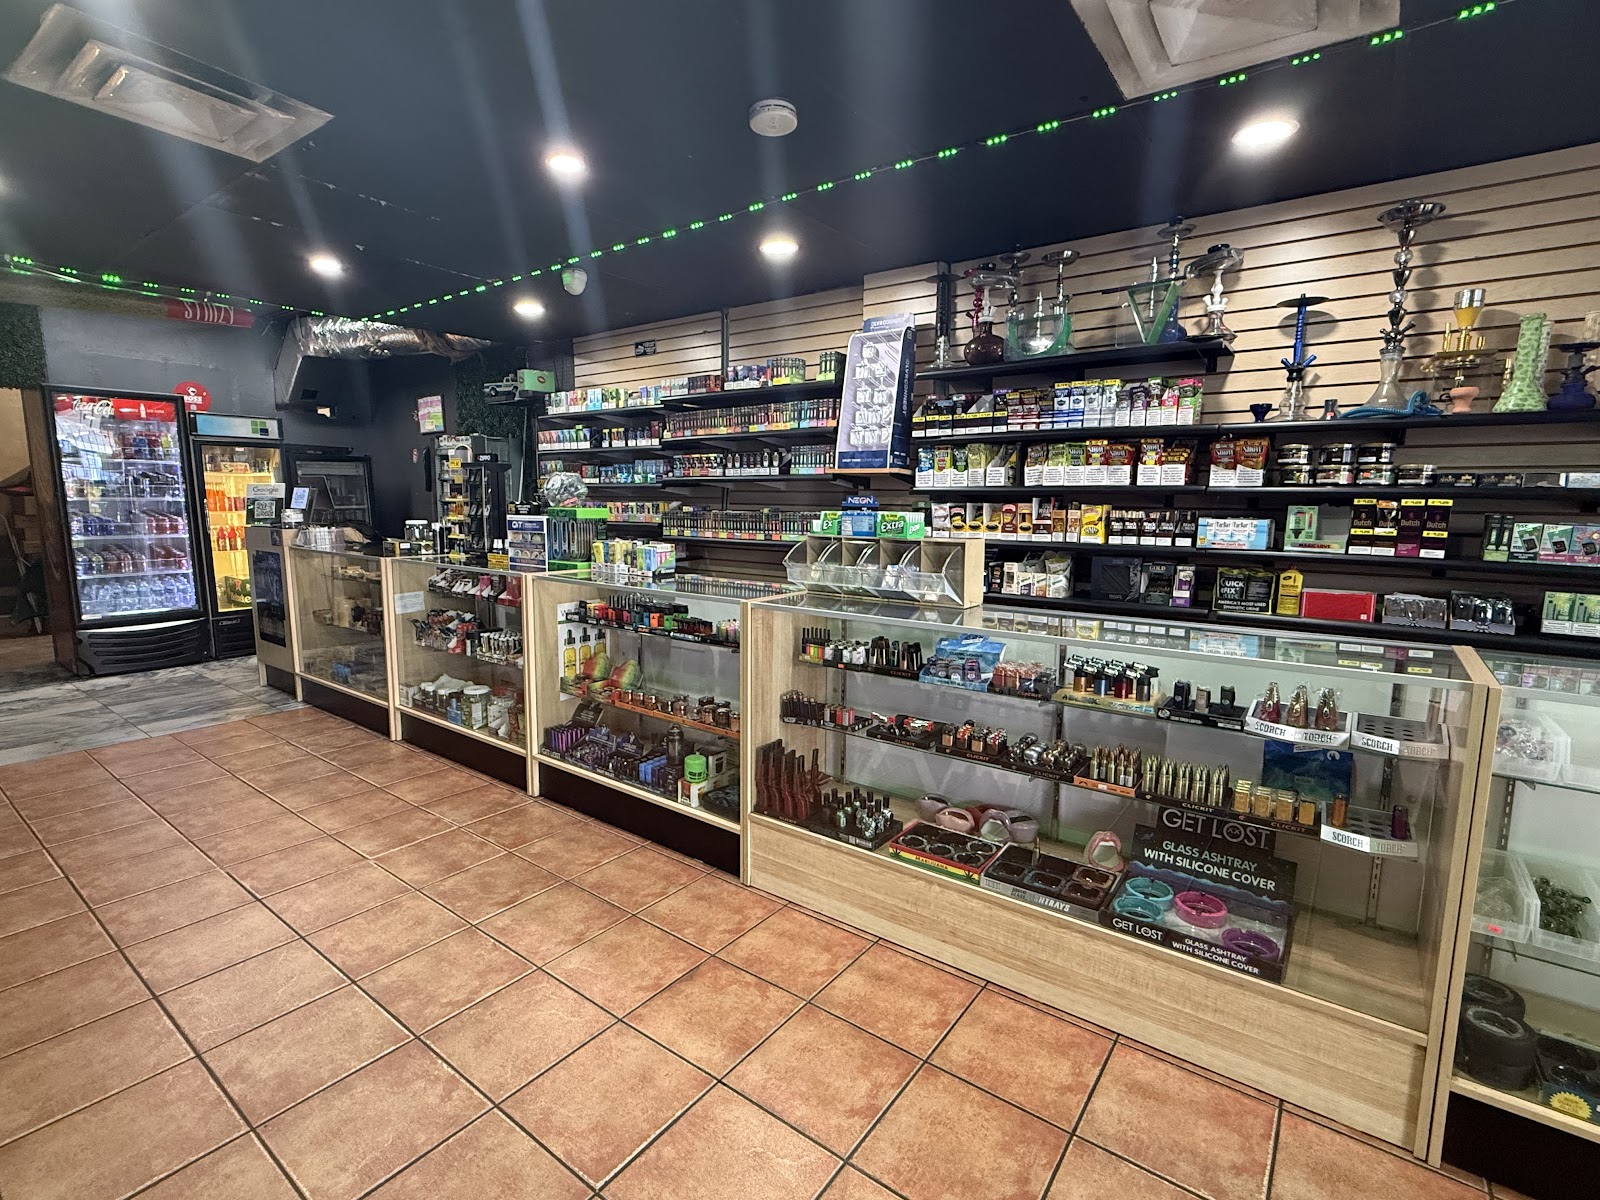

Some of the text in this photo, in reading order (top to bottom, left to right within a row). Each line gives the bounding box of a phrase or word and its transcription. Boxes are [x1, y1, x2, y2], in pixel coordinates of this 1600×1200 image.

[252, 486, 279, 494] Google
[881, 521, 904, 532] Extra
[1426, 521, 1447, 529] Dutch
[1255, 721, 1333, 744] SCORCH TORCH
[1361, 736, 1393, 752] SCORCH
[966, 753, 990, 762] CLICKIT
[1182, 802, 1214, 813] CLICKIT
[1162, 808, 1271, 849] GET LOST
[1270, 821, 1306, 833] CLICKIT
[1332, 831, 1363, 849] SCORCH
[1162, 840, 1258, 872] GLASS ASHTRAY
[1144, 848, 1277, 891] WITH SILICONE COVER
[1033, 895, 1071, 912] SHTRAYS
[1112, 918, 1163, 941] GET LOST
[1172, 941, 1259, 975] WITH SILICONE COVER
[1184, 938, 1247, 962] GLASS ASHTRAY
